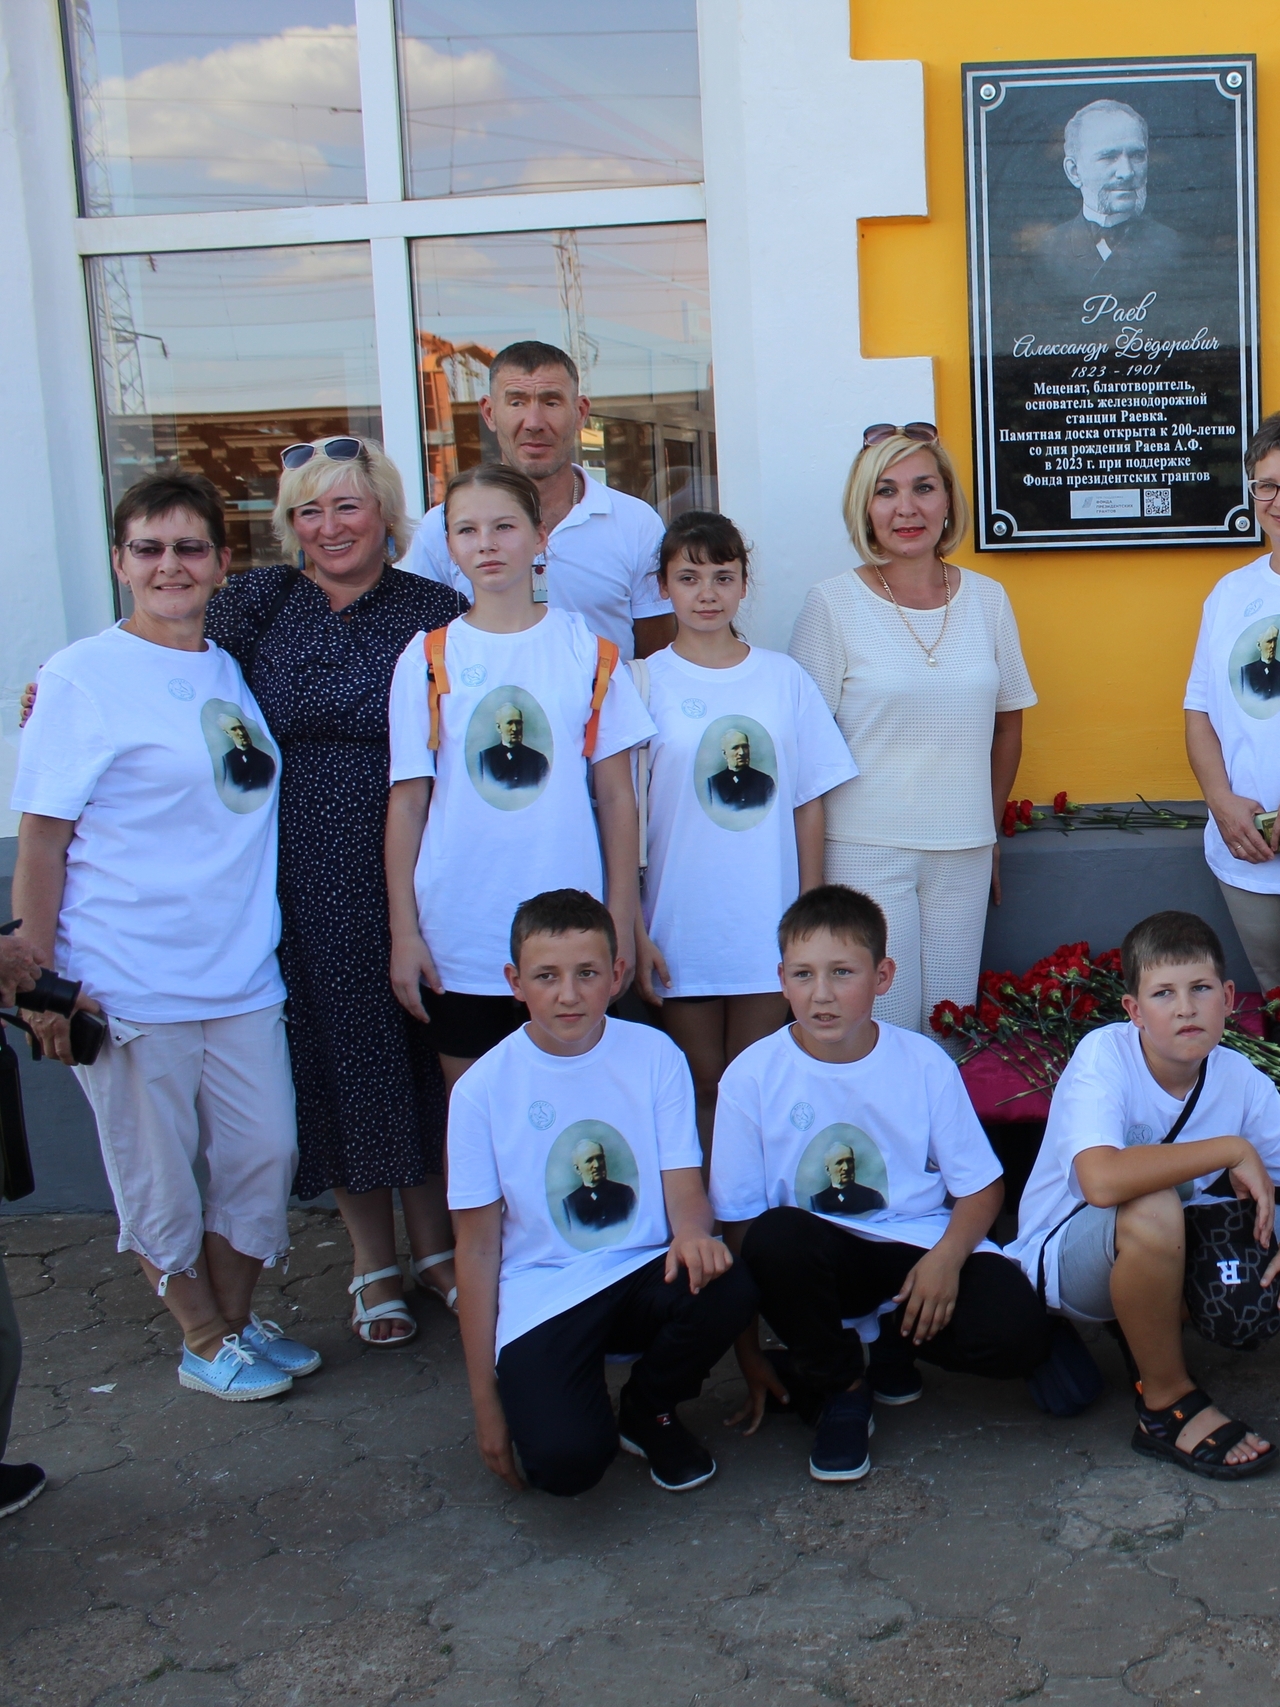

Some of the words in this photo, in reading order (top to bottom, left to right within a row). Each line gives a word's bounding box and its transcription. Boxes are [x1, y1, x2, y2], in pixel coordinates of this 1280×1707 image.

[1081, 291, 1157, 325] Раев
[1012, 333, 1110, 362] Александр
[1114, 325, 1220, 360] Фёдорович
[1071, 365, 1107, 378] 1823
[1126, 364, 1162, 376] 1901
[1033, 382, 1090, 396] Меценат,
[1093, 380, 1196, 395] благотворитель,
[1025, 399, 1095, 411] основатель
[1097, 393, 1208, 410] железнодорожной
[1065, 413, 1117, 425] станции
[1120, 409, 1168, 423] Раевка.
[999, 429, 1062, 442] Памятная
[1064, 428, 1100, 440] доска
[1103, 427, 1157, 440] открыта
[1160, 427, 1168, 437] к
[1171, 423, 1236, 436] 200-летию
[1029, 446, 1042, 456] со
[1045, 445, 1068, 457] дня
[1071, 443, 1131, 457] рождения
[1135, 440, 1171, 453] Раева
[1174, 438, 1203, 452] А.Ф.
[1044, 461, 1052, 471] в
[1055, 459, 1083, 470] 2023
[1086, 460, 1095, 470] г.
[1098, 459, 1122, 472] при
[1125, 456, 1192, 471] поддержке
[1022, 473, 1063, 488] Фонда
[1066, 471, 1159, 487] президентских
[1161, 472, 1211, 486] грантов
